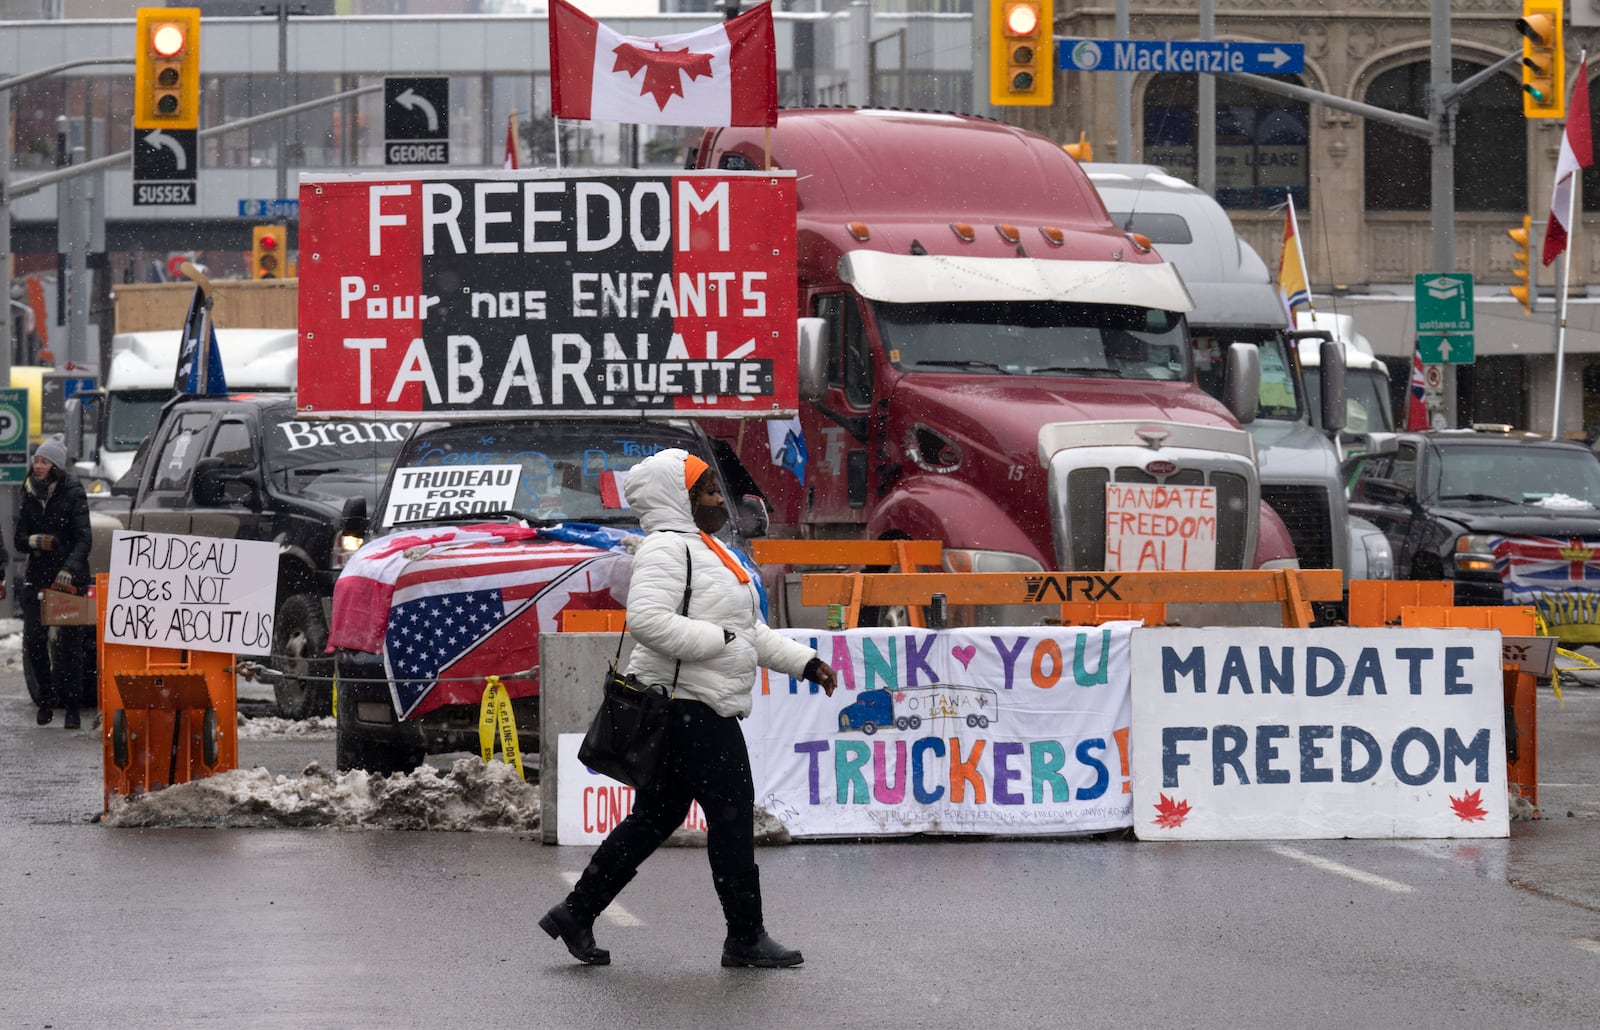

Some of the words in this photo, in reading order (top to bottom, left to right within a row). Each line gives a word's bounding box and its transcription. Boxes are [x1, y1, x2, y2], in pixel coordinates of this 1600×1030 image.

[1114, 42, 1245, 72] Mackenzie
[389, 145, 446, 163] GEORGE
[139, 186, 191, 203] SUSSEX
[368, 181, 731, 256] FREEDOM
[340, 276, 441, 320] Pour
[572, 272, 767, 318] ENFANTS
[402, 470, 513, 489] TRUDEAU
[1008, 464, 1025, 481] 15
[427, 489, 476, 499] FOR
[1107, 486, 1214, 509] MANDATE
[392, 500, 507, 521] TREASON
[1107, 511, 1216, 541] FREEDOM
[120, 534, 237, 574] TRUDEAU
[1107, 539, 1121, 571] 4
[118, 576, 172, 601] DOES
[183, 574, 231, 604] NOT
[110, 604, 158, 640] CARE
[165, 608, 241, 642] ABOUT
[241, 610, 272, 648] US
[761, 632, 939, 696] ANK
[990, 629, 1112, 690] YOU
[1161, 645, 1475, 697] MANDATE
[908, 693, 971, 710] OTTAWA
[794, 727, 1132, 805] TRUCKERS!
[1162, 724, 1491, 788] FREEDOM
